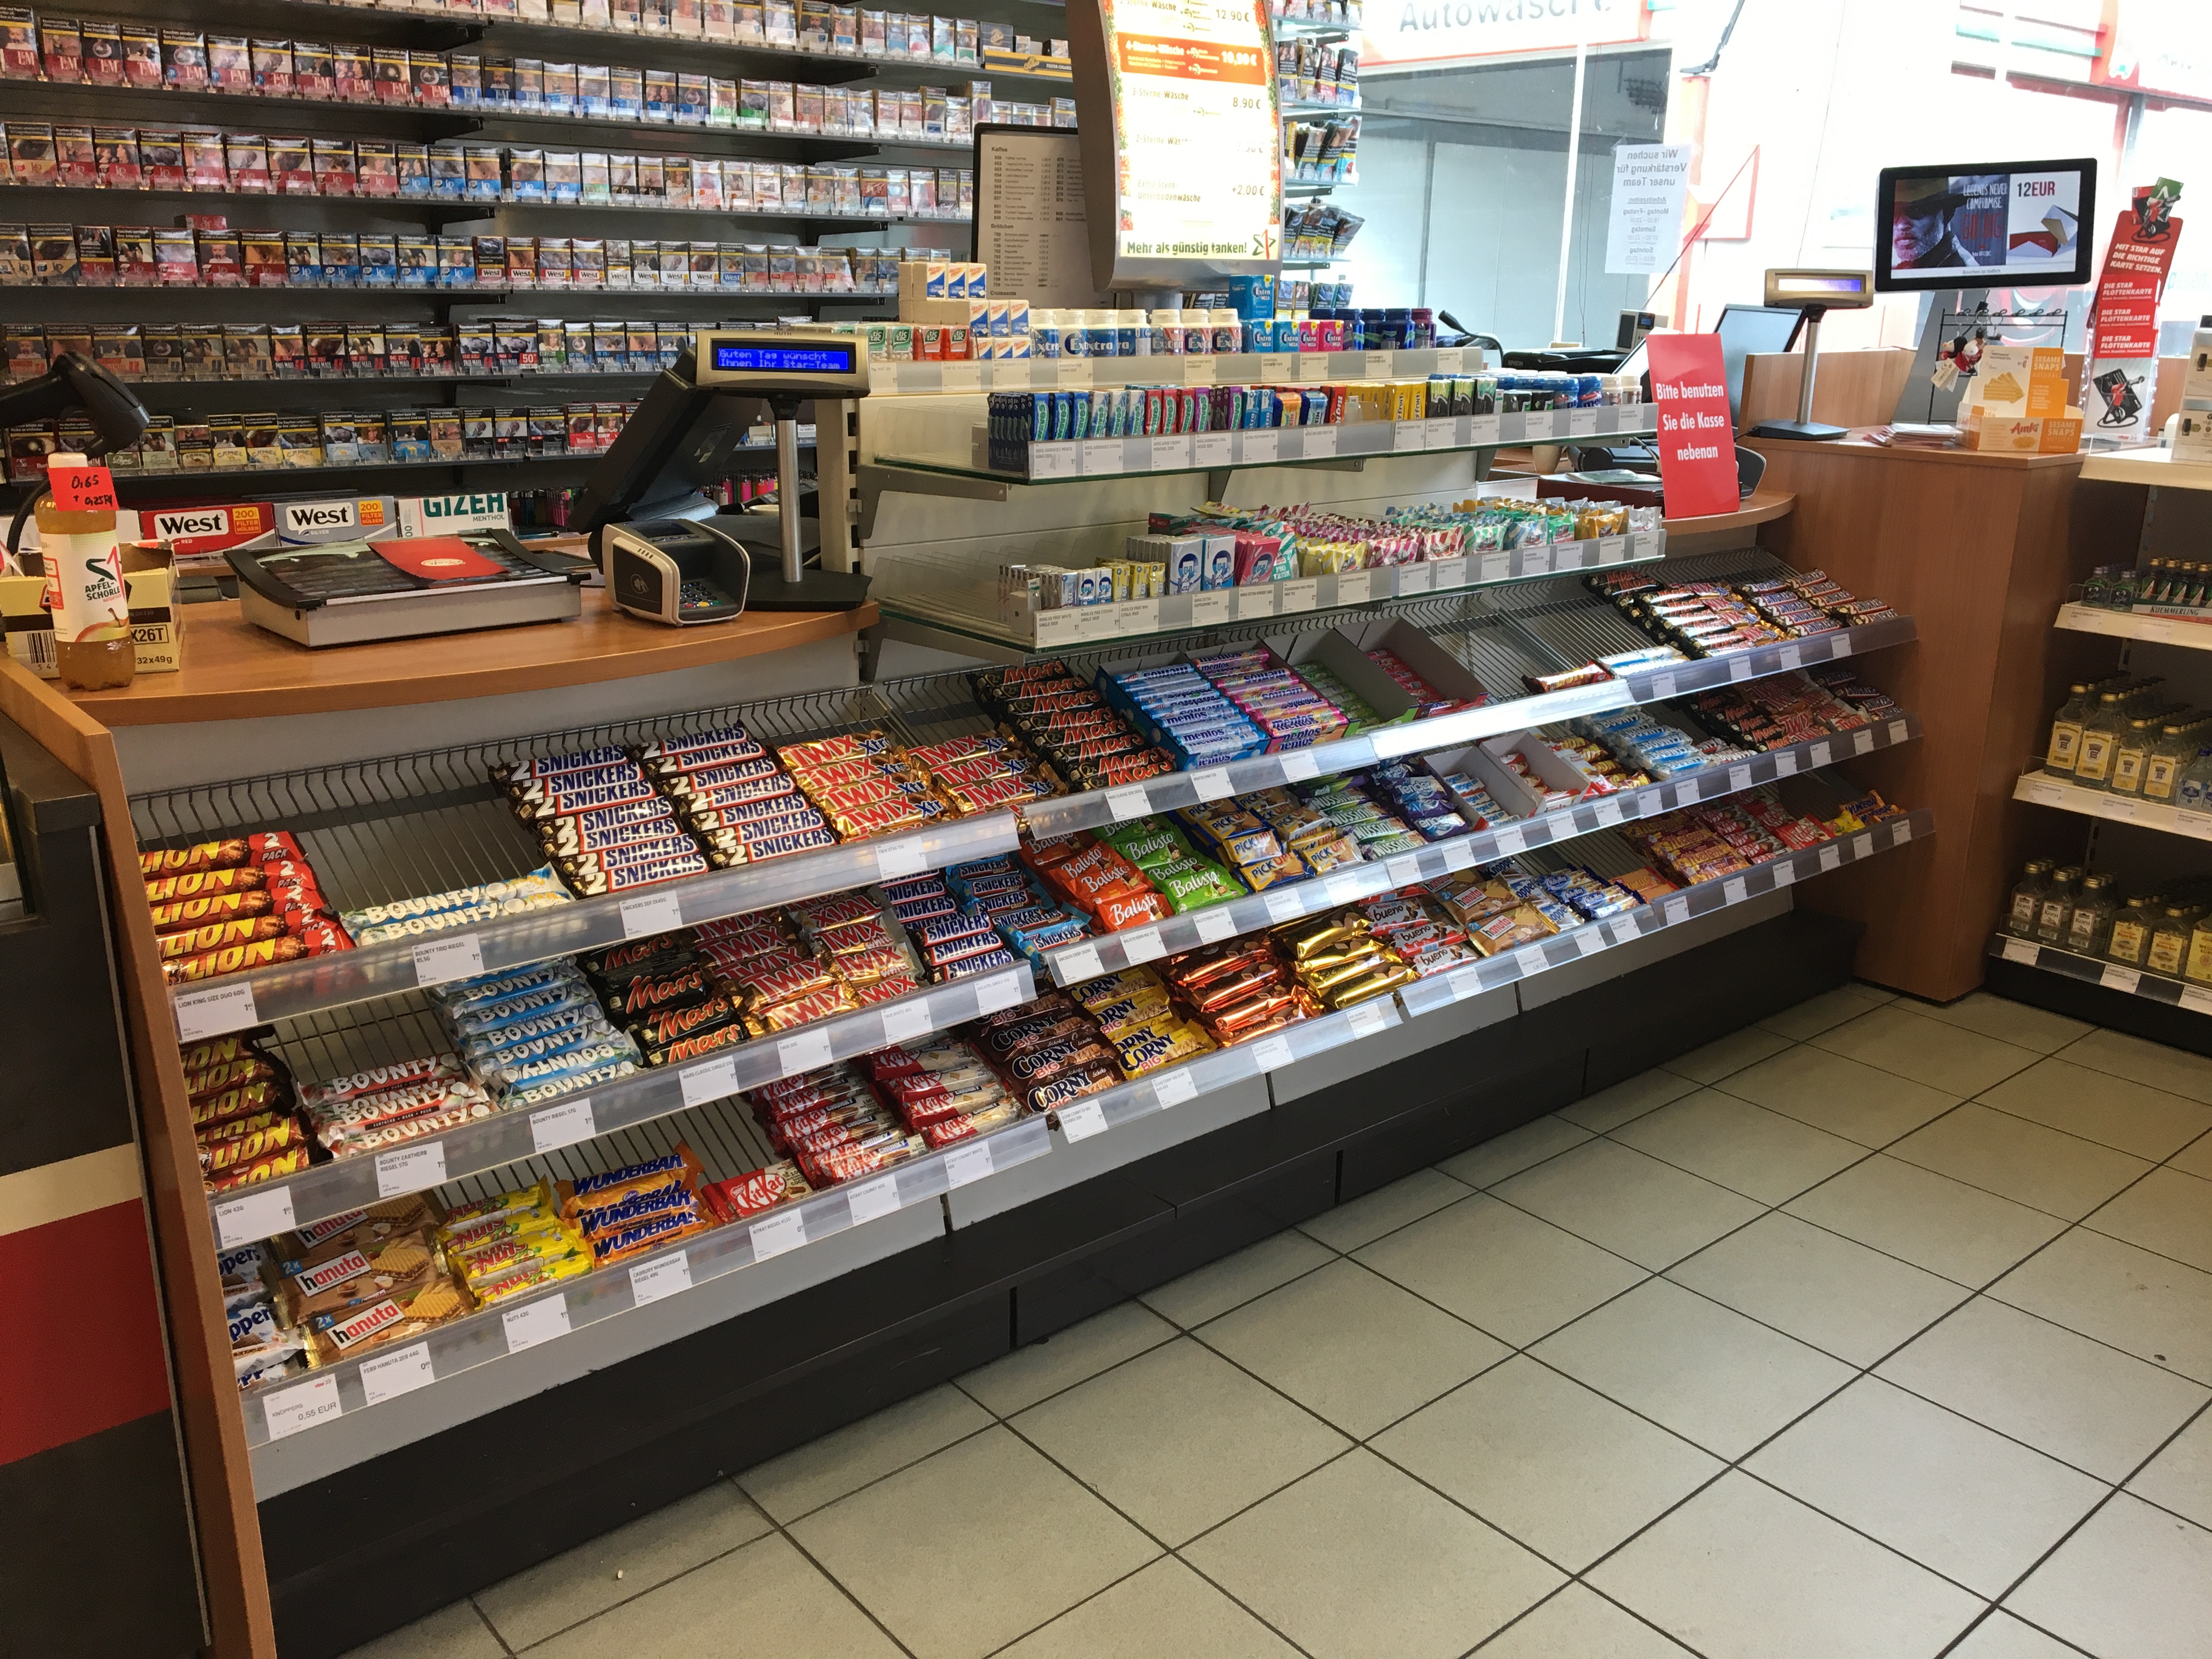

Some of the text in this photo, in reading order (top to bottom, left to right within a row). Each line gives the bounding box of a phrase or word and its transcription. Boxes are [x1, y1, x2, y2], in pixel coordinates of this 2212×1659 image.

[1989, 183, 2008, 195] NEVER
[2017, 181, 2055, 197] 12EUR
[1962, 214, 1978, 239] GO
[1127, 241, 1247, 255] Mehr als günstig tanken!
[2126, 253, 2160, 264] RICHTIGE
[2130, 245, 2148, 253] STAR
[2149, 247, 2165, 256] AUF
[2110, 261, 2162, 274] KARTE SETZEN.
[759, 351, 777, 359] Tag
[783, 352, 827, 360] wünscht
[783, 360, 840, 369] Star-Team
[1656, 381, 1724, 400] Bitte benutzen
[1662, 413, 1724, 431] Sie die Kasse
[1677, 443, 1718, 461] nebenan
[71, 475, 99, 488] 0,65
[291, 503, 379, 526] West 200
[424, 494, 504, 517] GIZEH
[160, 515, 223, 534] West
[84, 581, 115, 593] APFEL-
[86, 586, 121, 601] SCHORLE
[2150, 606, 2200, 616] KUEMMERLING
[137, 656, 172, 665] 32x49g
[1005, 661, 1065, 684] Mars
[1034, 689, 1101, 713] Mars
[1165, 712, 1215, 726] mentos
[666, 725, 746, 752] SNICKERS
[538, 744, 626, 775] SNICKERS
[778, 735, 862, 766] TWIX
[550, 761, 640, 794] SNICKERS
[695, 758, 775, 788] SNICKERS
[817, 776, 900, 808] TWIX
[583, 797, 671, 833] SNICKERS
[742, 808, 821, 840] SNICKERS
[836, 795, 918, 831] TWIX
[262, 847, 289, 862] PACK
[753, 828, 834, 860] SNICKERS
[1126, 833, 1173, 861] Balisto
[146, 867, 236, 901] LION
[584, 872, 607, 894] 2
[1169, 871, 1219, 898] Balisto
[364, 885, 483, 926] BOUNTY
[623, 902, 643, 911] SNICKERS
[1454, 887, 1484, 906] hanuta
[385, 902, 500, 939] BOUNTY
[1373, 905, 1404, 922] bueno
[162, 917, 257, 957] LION
[1401, 926, 1431, 941] bueno
[415, 948, 435, 957] BOUNTY
[448, 941, 465, 951] RIEGEL
[182, 939, 277, 982] LION
[178, 1000, 191, 1008] LION
[193, 997, 207, 1006] KING
[207, 995, 219, 1003] SIZE
[628, 969, 702, 1013] Mars
[488, 1010, 579, 1046] BOUNTY
[659, 998, 727, 1042] Mars
[1012, 1041, 1076, 1079] CORNY
[1119, 1035, 1172, 1071] CORNY
[1141, 1056, 1162, 1071] BIG
[332, 1056, 436, 1094] BOUNTY
[1035, 1062, 1060, 1079] BIG
[524, 1066, 617, 1103] BOUNTY
[191, 1082, 268, 1124] LION
[826, 1098, 856, 1111] CHUNKY
[362, 1108, 468, 1149] BOUNTY
[532, 1115, 551, 1125] BOUNTY
[551, 1111, 567, 1119] RIEGEL
[215, 1117, 290, 1167] LION
[380, 1150, 427, 1165] BOUNTY ZARTHERB
[742, 1172, 785, 1207] KitKat
[219, 1208, 232, 1217] LION
[580, 1190, 691, 1236] WUNDERBAR
[458, 1219, 505, 1248] Nuts
[593, 1211, 699, 1259] WUNDERBAR
[753, 1221, 781, 1234] KITKAT RIEGEL
[301, 1254, 366, 1290] hanuta
[633, 1257, 681, 1278] CADBURY WUNDERBAR
[634, 1275, 650, 1284] RIEGEL
[333, 1304, 399, 1345] hanuta
[507, 1314, 520, 1323] NUTS
[377, 1358, 398, 1369] HANUTA
[272, 1403, 303, 1418] KNOPPERS
[298, 1401, 337, 1421] 0,55 EUR
